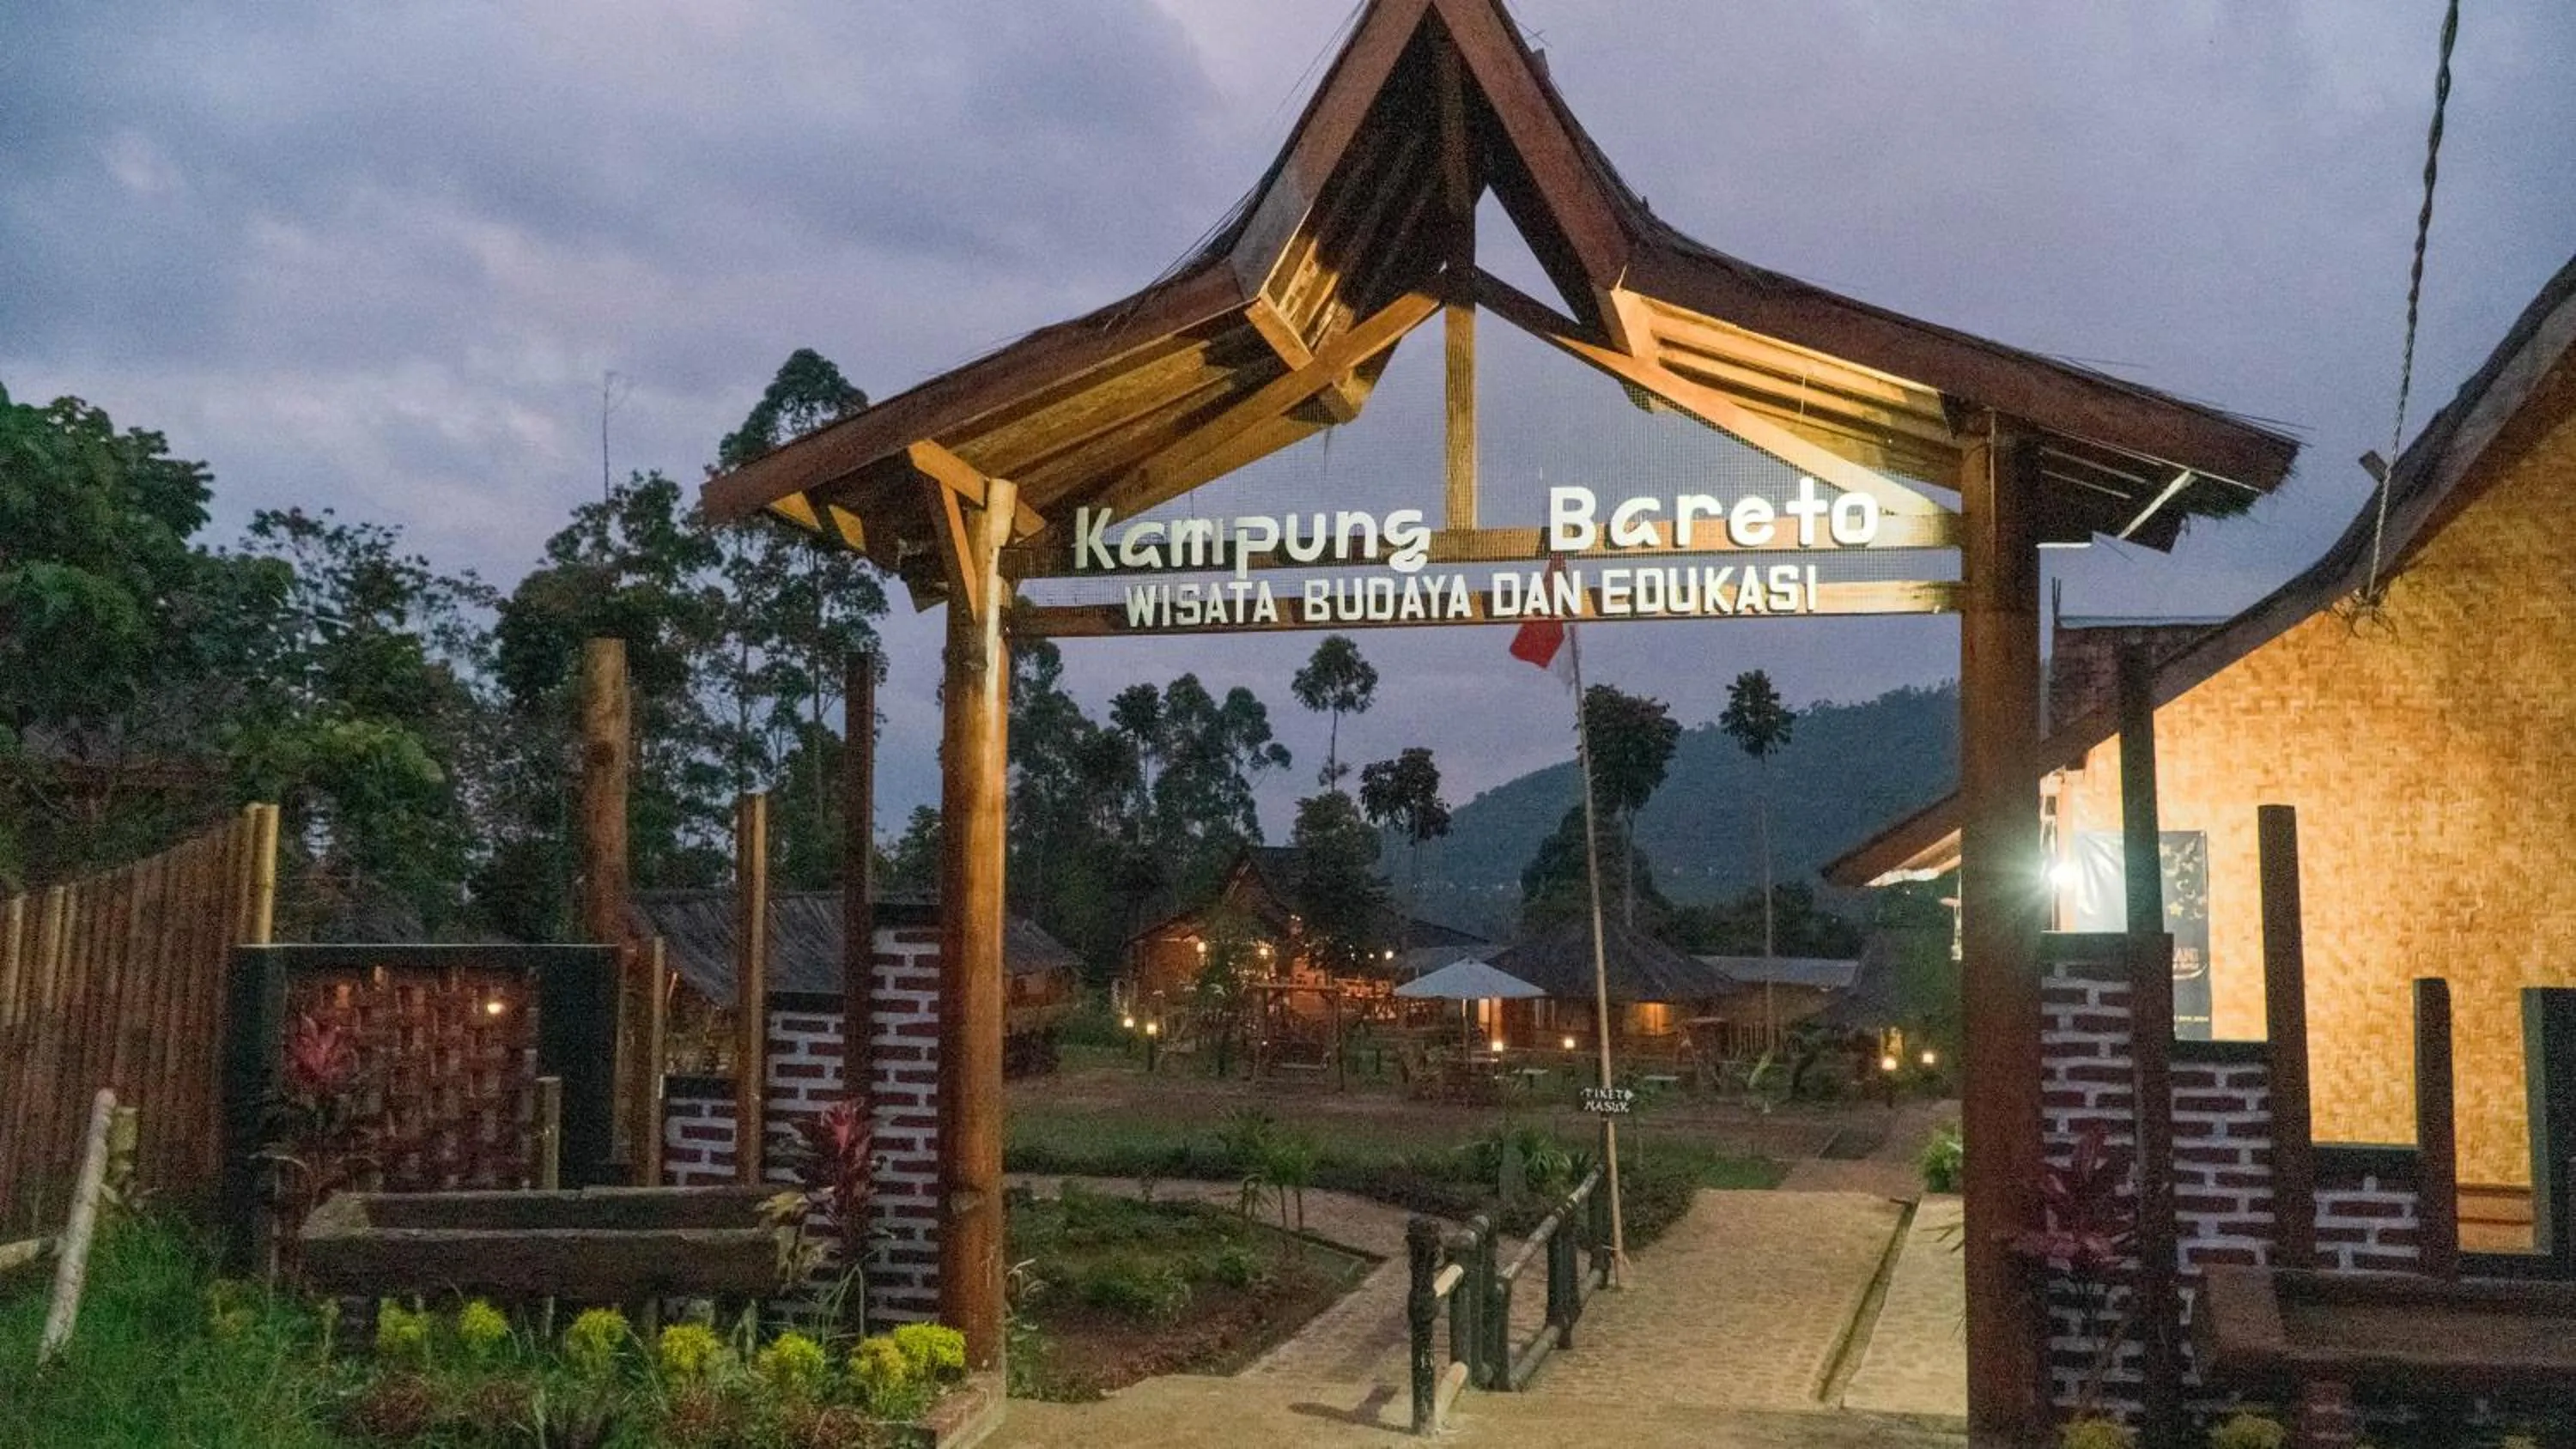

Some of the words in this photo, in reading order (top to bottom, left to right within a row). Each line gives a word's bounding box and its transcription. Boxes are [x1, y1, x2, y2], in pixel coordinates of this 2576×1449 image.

[1073, 506, 1431, 579] Kampung
[1549, 477, 1880, 552] Bareto
[1125, 580, 1279, 627] WISATA
[1303, 573, 1473, 622] BUDAYA
[1492, 571, 1582, 617] DAN
[1601, 565, 1818, 614] EDUKASI
[1583, 1100, 1630, 1113] MASUK
[1584, 1088, 1623, 1100] TIKET
